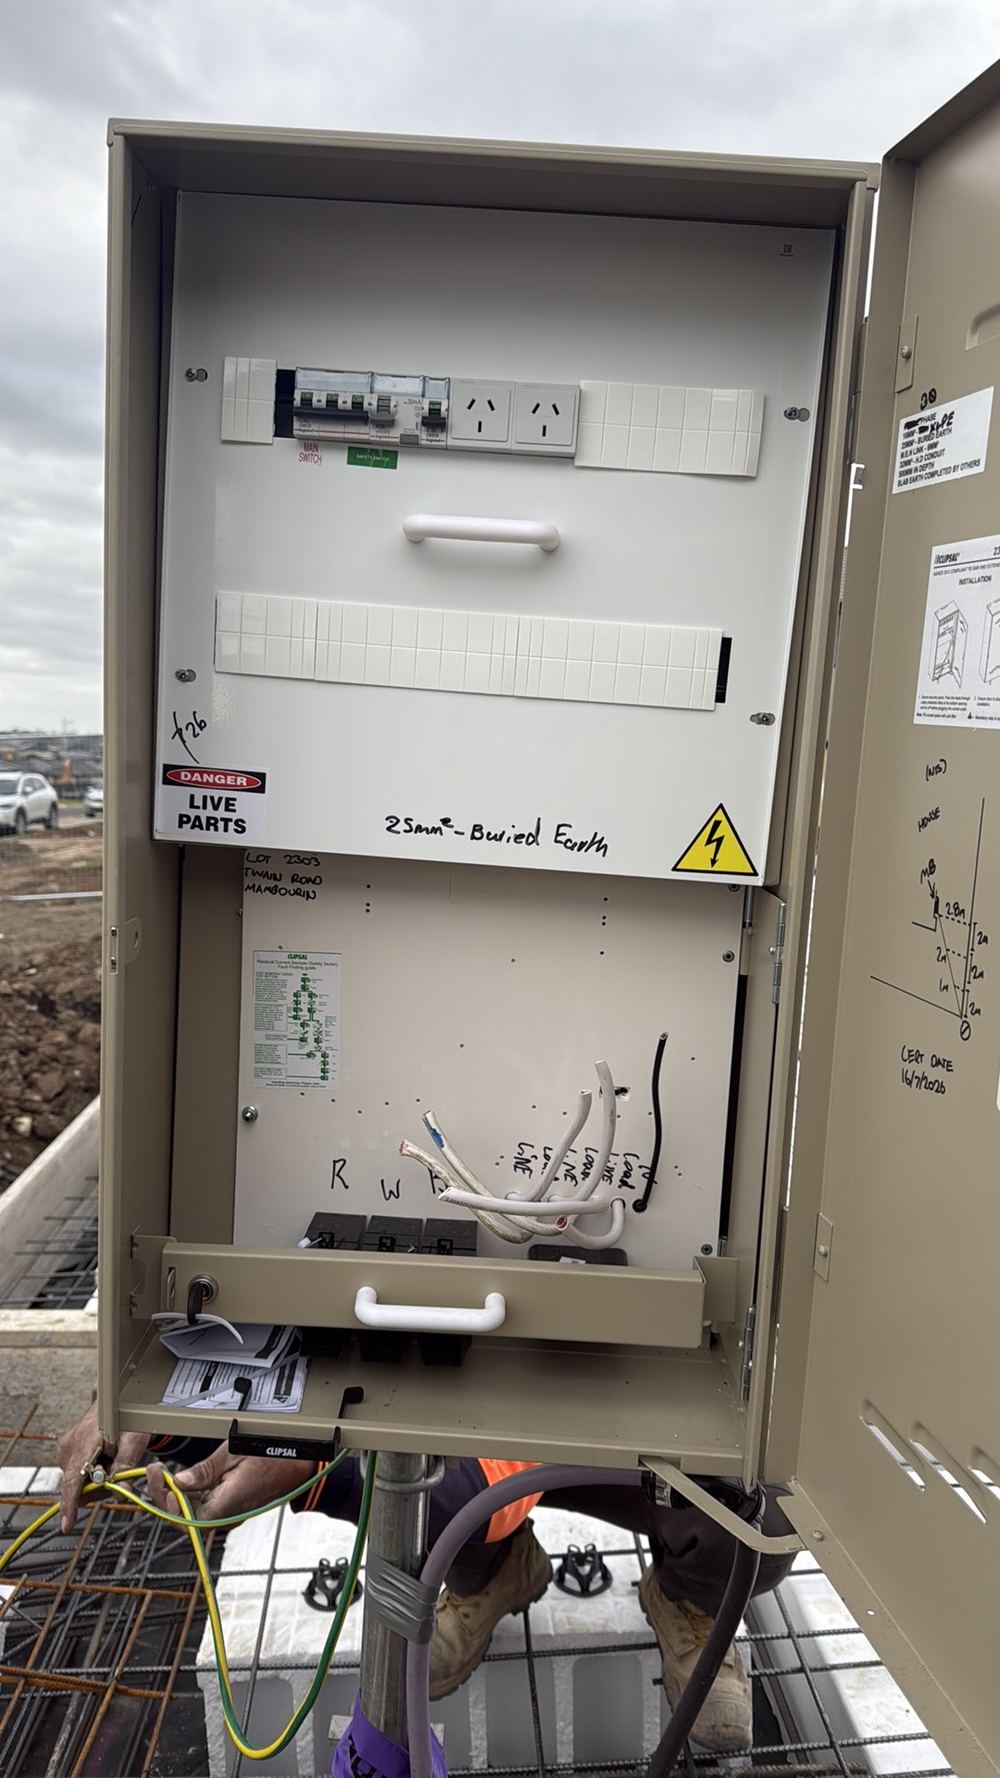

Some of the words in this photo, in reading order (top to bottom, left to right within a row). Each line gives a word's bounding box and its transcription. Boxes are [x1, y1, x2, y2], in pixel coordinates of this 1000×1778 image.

[930, 411, 955, 434] XLPE
[918, 431, 935, 445] BURIED
[935, 426, 952, 439] EARTH
[303, 441, 319, 453] MAIN
[913, 445, 924, 456] LINK
[924, 448, 946, 461] CONDUIT
[298, 451, 322, 465] SWITCH
[919, 461, 936, 472] DEPTH
[897, 477, 908, 487] SLAB
[909, 474, 924, 484] EARTH
[924, 466, 952, 480] COMPLETED
[953, 464, 960, 473] BY
[960, 458, 981, 471] OTHERS
[959, 575, 993, 586] INSTALLATION
[180, 771, 248, 786] DANGER
[189, 793, 237, 813] LIVE
[177, 813, 247, 834] PARTS
[917, 806, 941, 832] HOUSE
[553, 823, 608, 857] Earth
[246, 852, 272, 864] LOT
[283, 854, 321, 867] 2303
[244, 867, 282, 882] TWAIN
[290, 873, 323, 885] ROAD
[920, 858, 937, 884] MB
[901, 1045, 925, 1065] CERT
[930, 1054, 954, 1073] DATE
[330, 1158, 349, 1190] R
[618, 1152, 640, 1190] Load
[381, 1178, 401, 1201] W
[266, 1446, 297, 1458] CLIPSAL
